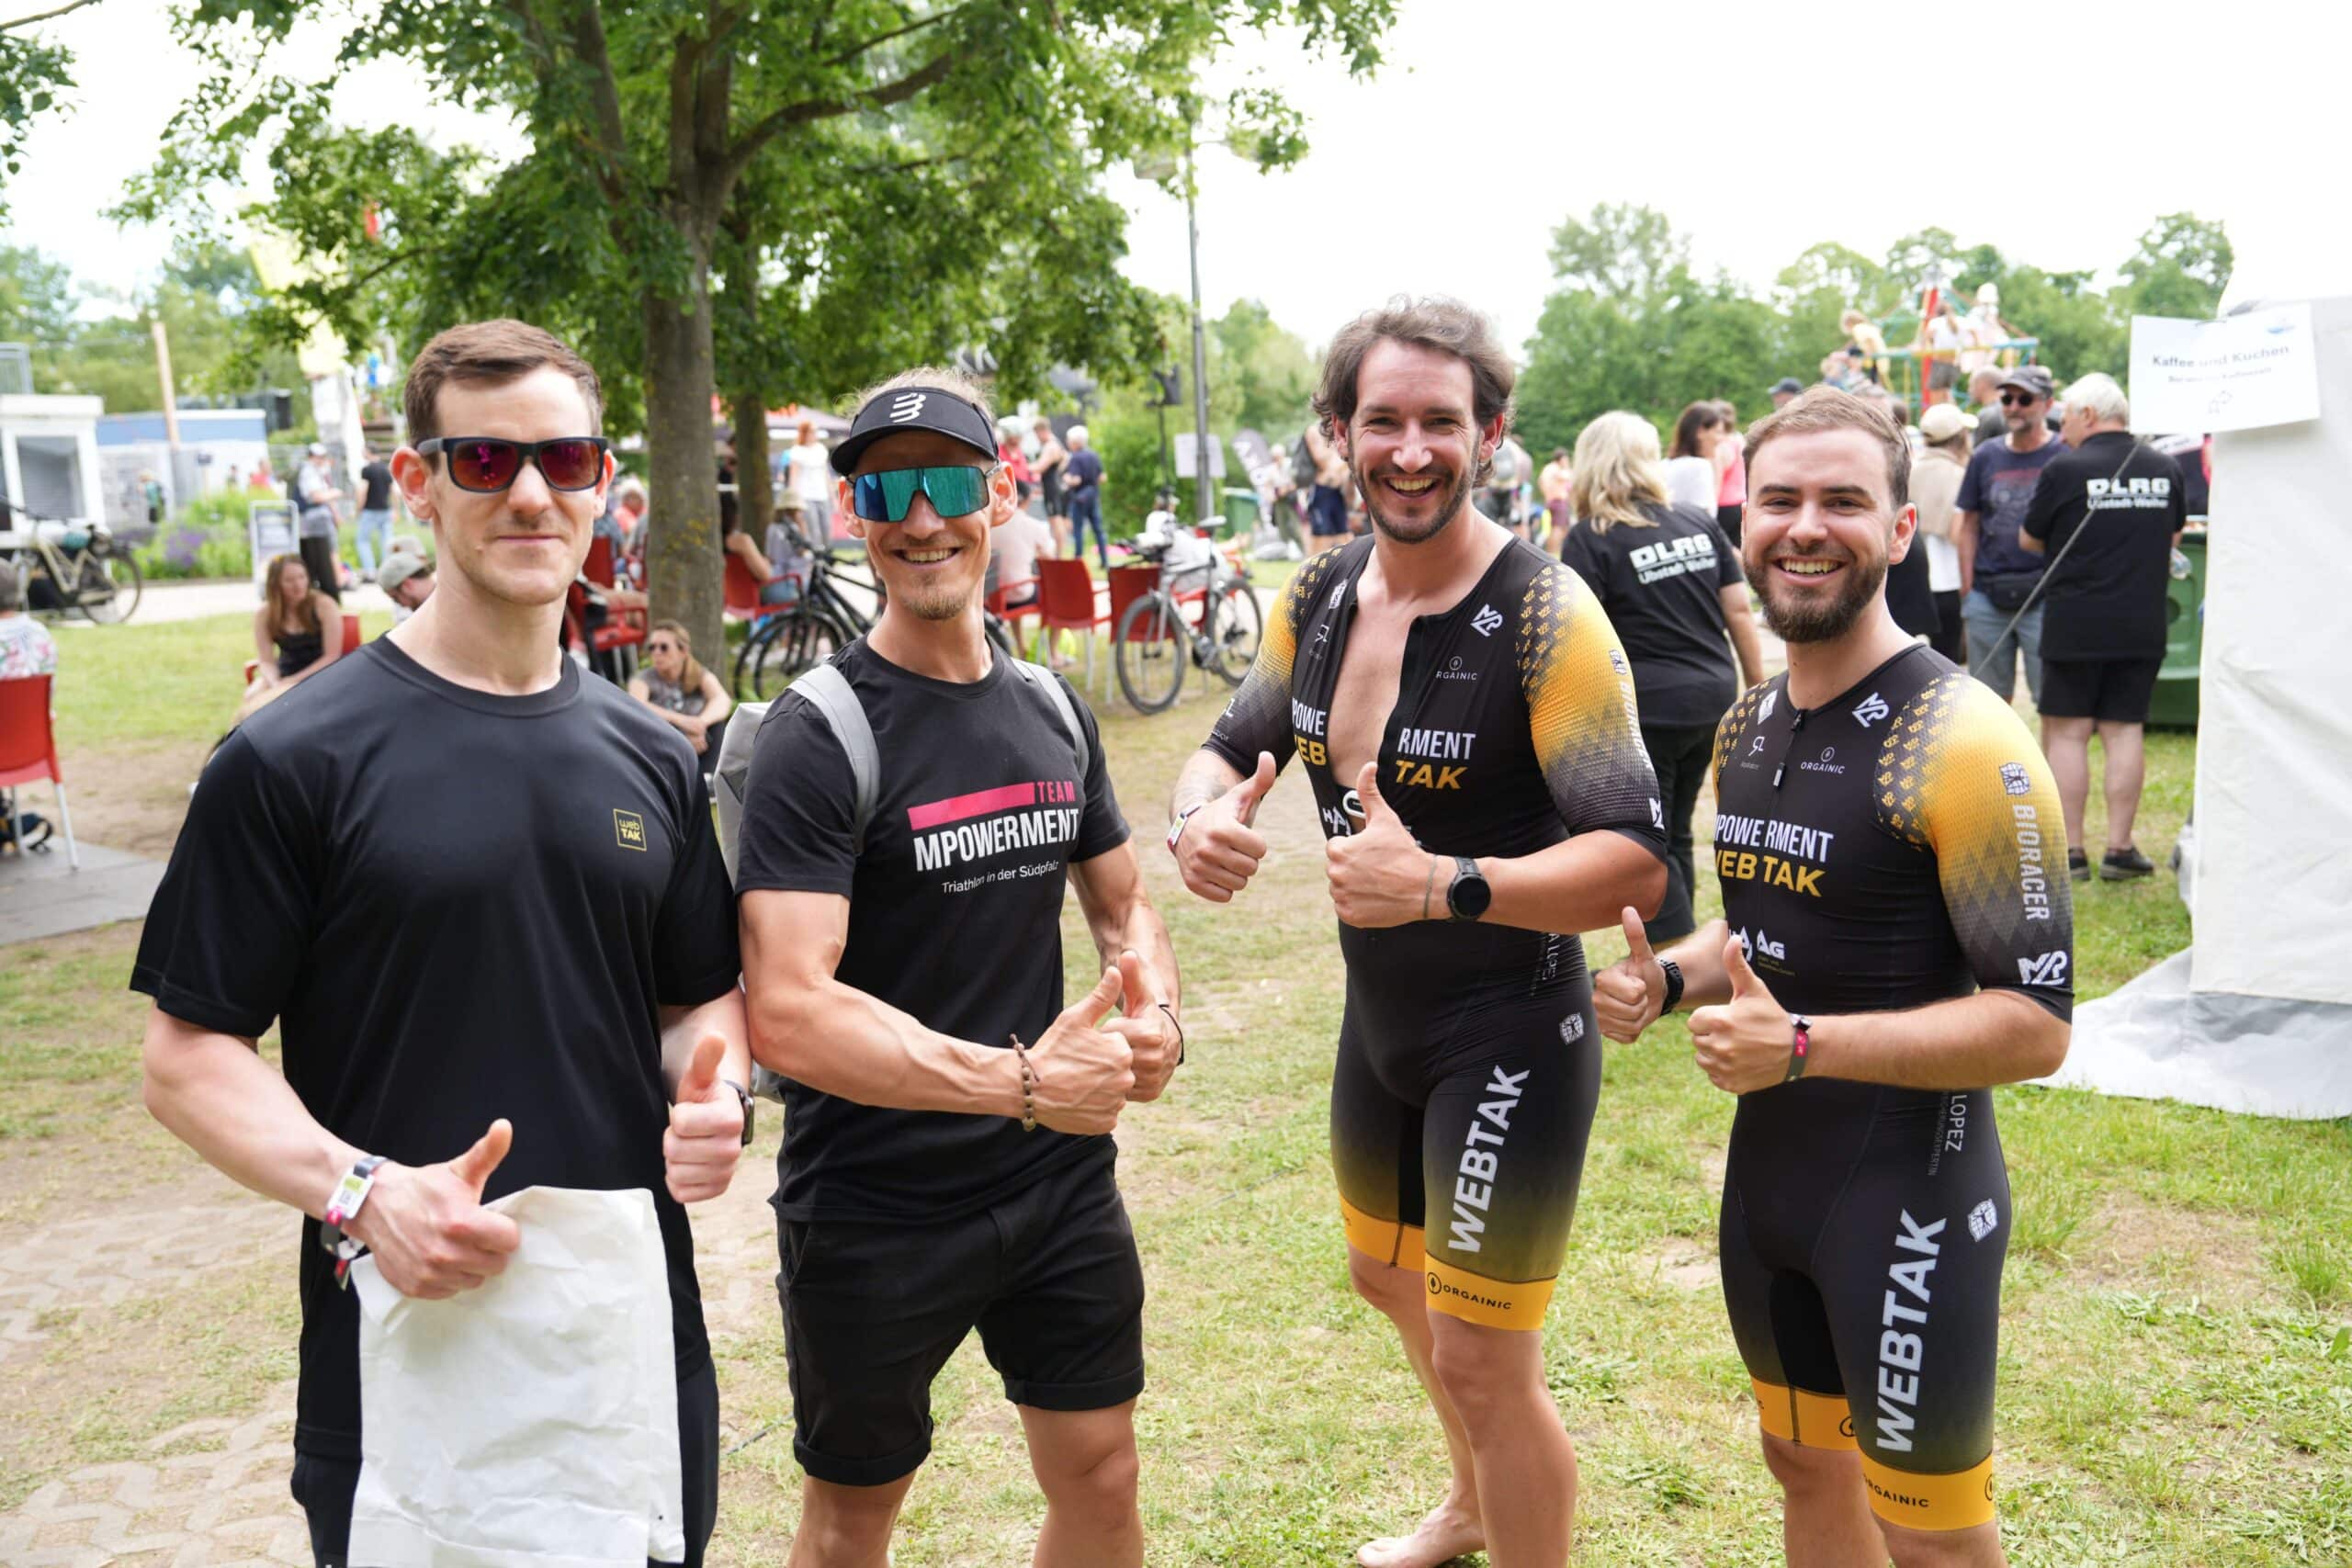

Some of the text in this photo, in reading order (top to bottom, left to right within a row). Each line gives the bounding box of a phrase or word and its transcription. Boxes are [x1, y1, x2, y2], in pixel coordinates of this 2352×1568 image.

[2153, 355, 2195, 367] Kaffee
[2232, 345, 2290, 363] Kuchen
[2086, 477, 2170, 496] DLRG
[1629, 533, 1713, 570] DLRG
[1436, 671, 1478, 681] RGAINIC
[1292, 696, 1476, 761] POWE RMENT
[1295, 735, 1470, 789] EB TAK
[1800, 761, 1846, 774] ORGAINIC
[1037, 781, 1076, 804] TEAM
[620, 828, 642, 842] TAK
[913, 808, 1080, 872] MPOWERMENT
[942, 859, 1059, 894] Triathlon in der Südpfalz
[2013, 804, 2050, 920] BIORACER
[1944, 1094, 1968, 1152] LOPEZ
[1447, 1065, 1531, 1253] WEBTAK
[1442, 1284, 1512, 1310] ORGAINIC
[1876, 1208, 1948, 1452] WEBTAK
